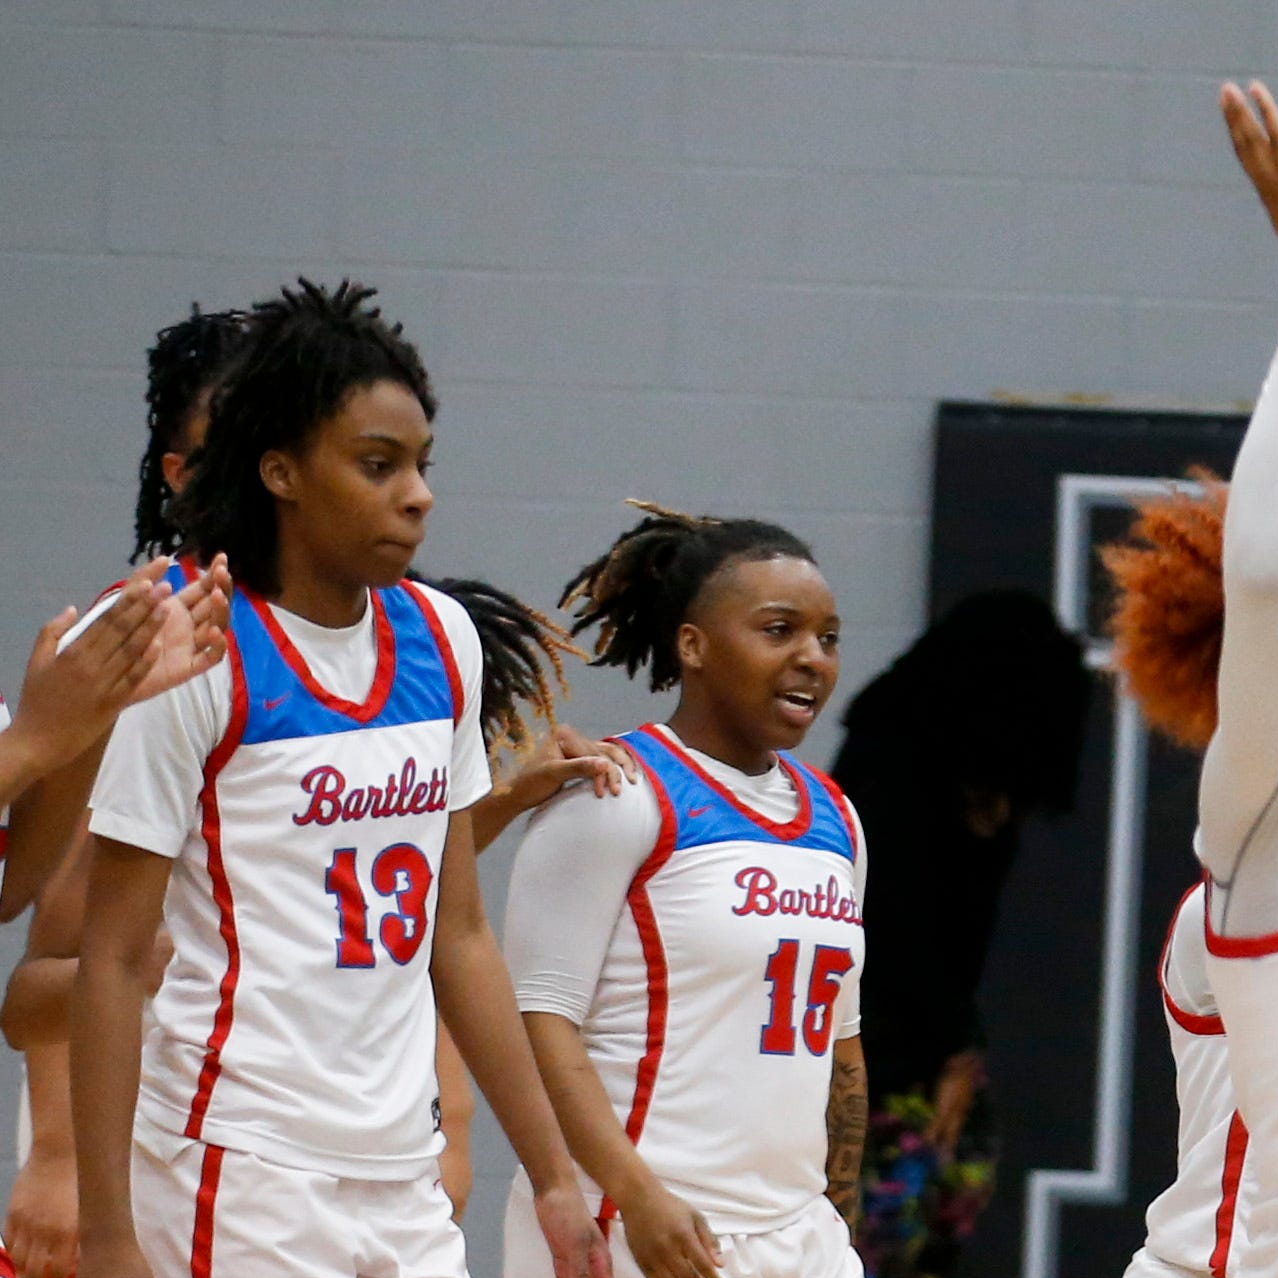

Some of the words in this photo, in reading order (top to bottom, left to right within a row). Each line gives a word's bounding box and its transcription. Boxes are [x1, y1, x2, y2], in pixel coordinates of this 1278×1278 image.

[292, 756, 448, 826] Bartlett
[325, 842, 433, 968] 13
[760, 938, 855, 1056] 15
